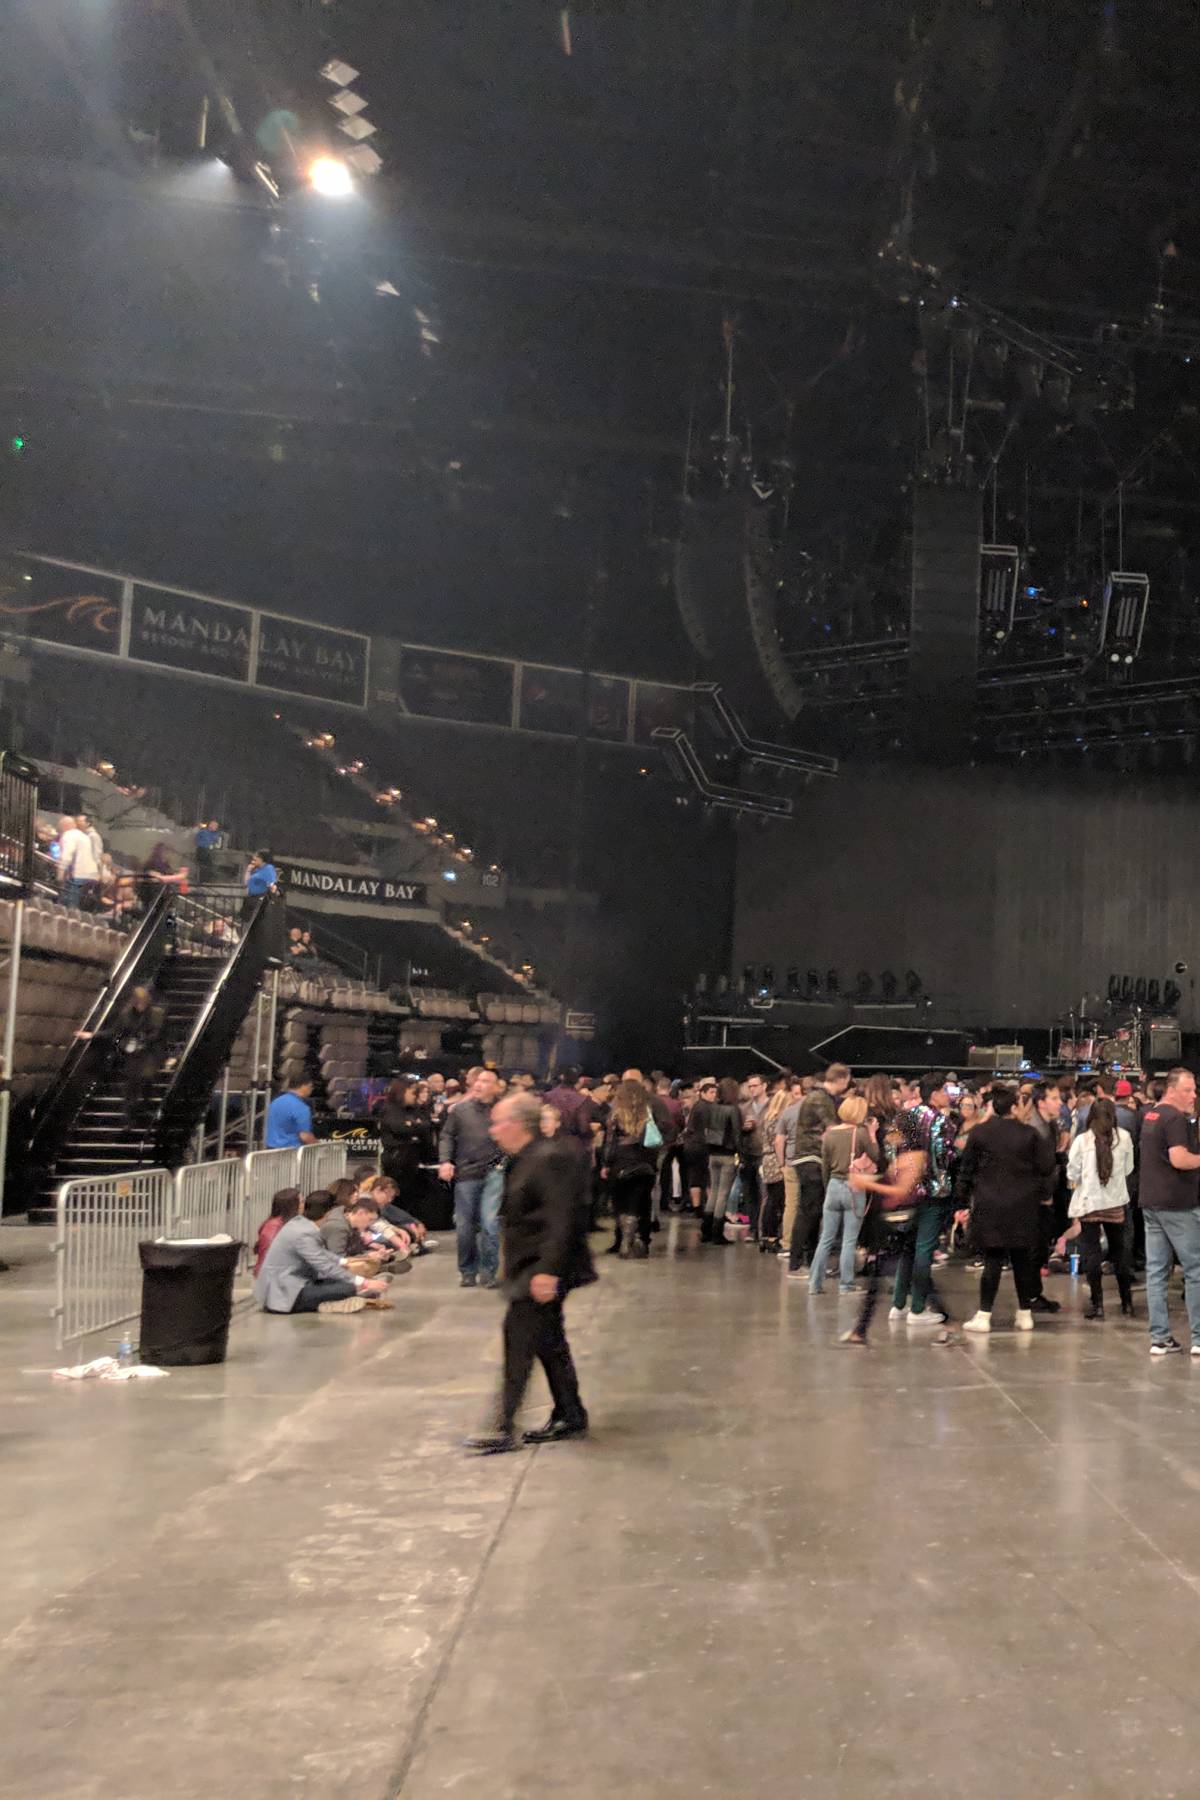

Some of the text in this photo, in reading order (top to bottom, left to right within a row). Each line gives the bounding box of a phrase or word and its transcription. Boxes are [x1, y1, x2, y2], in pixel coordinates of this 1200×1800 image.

[143, 606, 304, 657] MANDALAY
[290, 869, 417, 900] MANDALAY BAY
